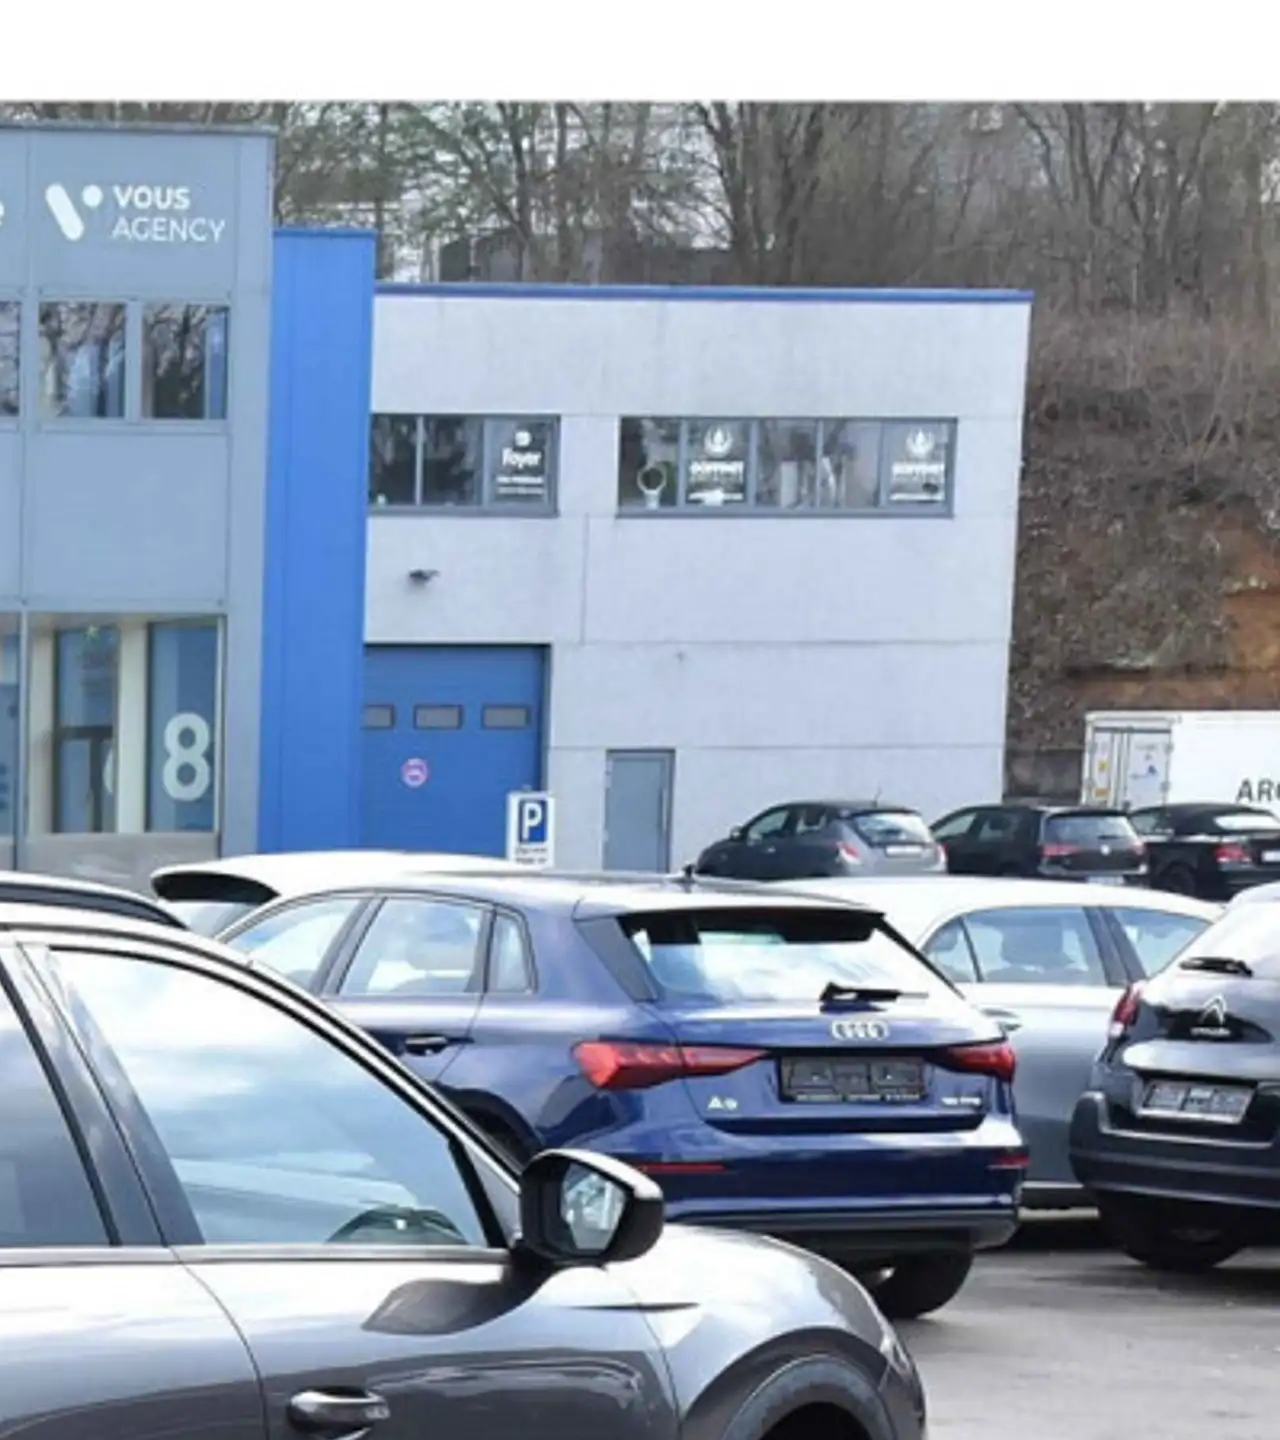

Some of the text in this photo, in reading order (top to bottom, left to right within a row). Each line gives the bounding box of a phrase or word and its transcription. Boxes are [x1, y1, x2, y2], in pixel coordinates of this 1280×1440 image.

[112, 185, 192, 211] VOUS
[111, 216, 226, 243] AGENCY
[162, 712, 211, 802] 8
[1236, 778, 1280, 803] AR
[521, 802, 543, 841] P
